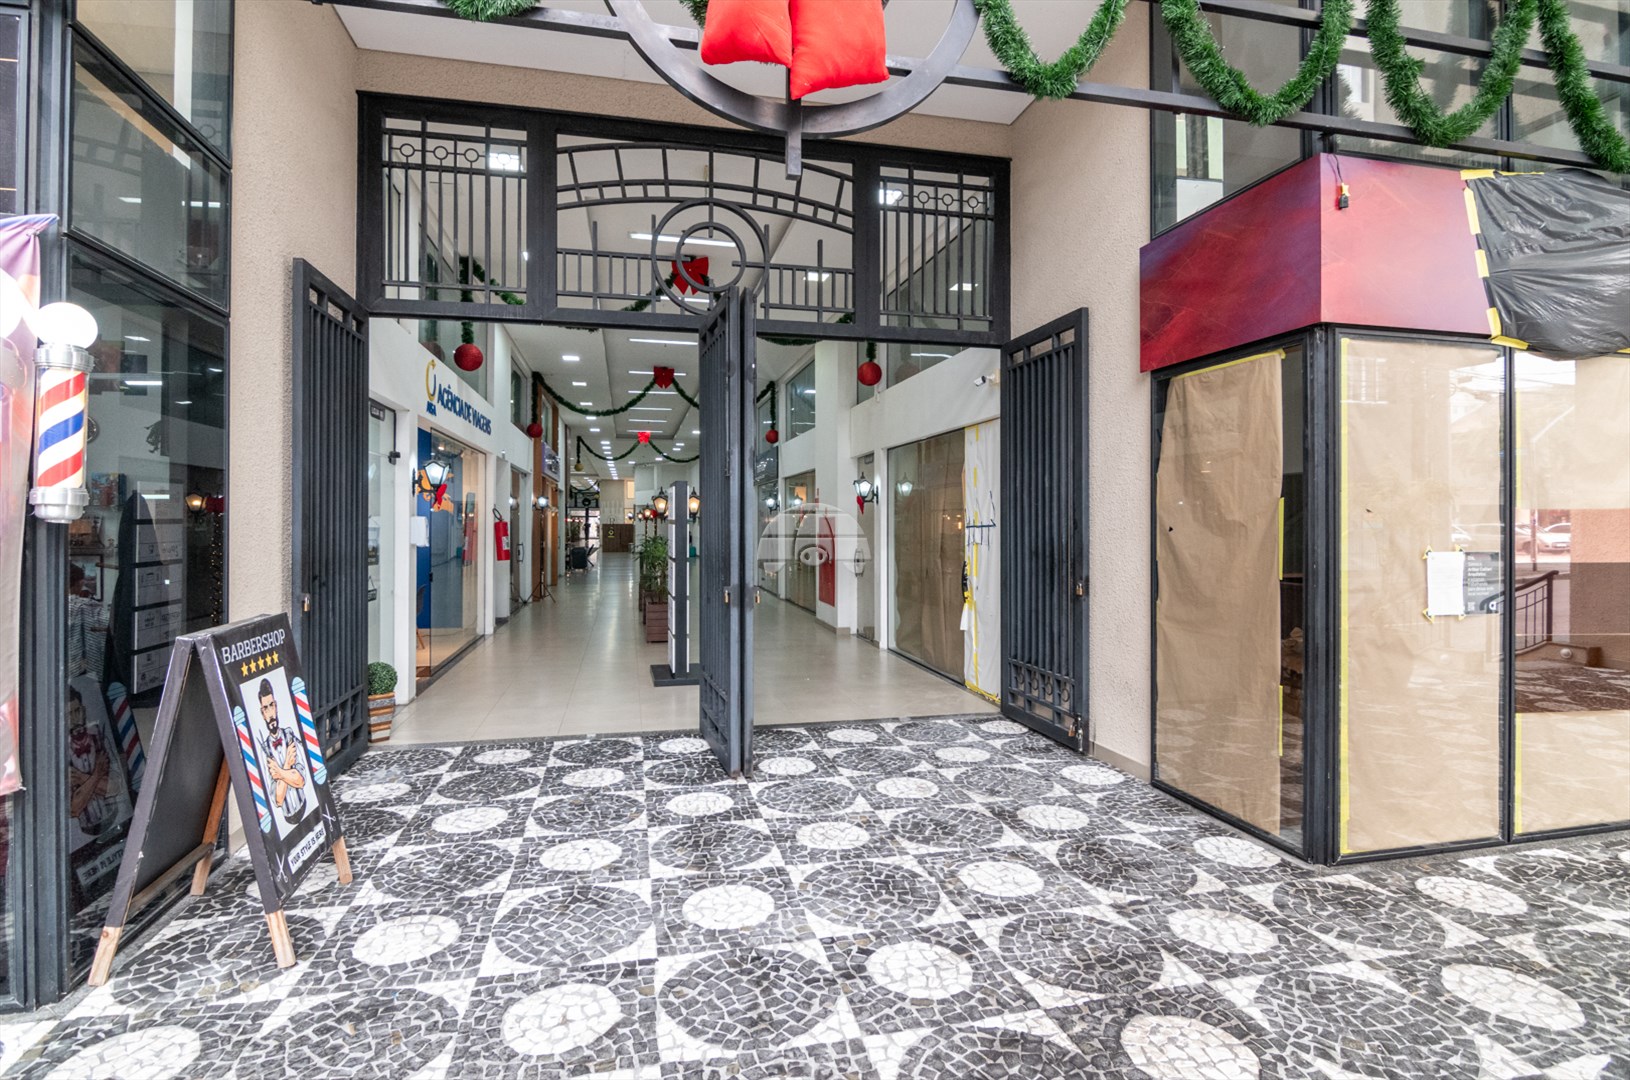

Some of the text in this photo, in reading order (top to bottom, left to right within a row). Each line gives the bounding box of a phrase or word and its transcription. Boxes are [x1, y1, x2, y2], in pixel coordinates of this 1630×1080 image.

[437, 383, 464, 418] AGÊNCIA
[221, 628, 286, 665] BARBERSHOP
[300, 840, 312, 857] STYLE
